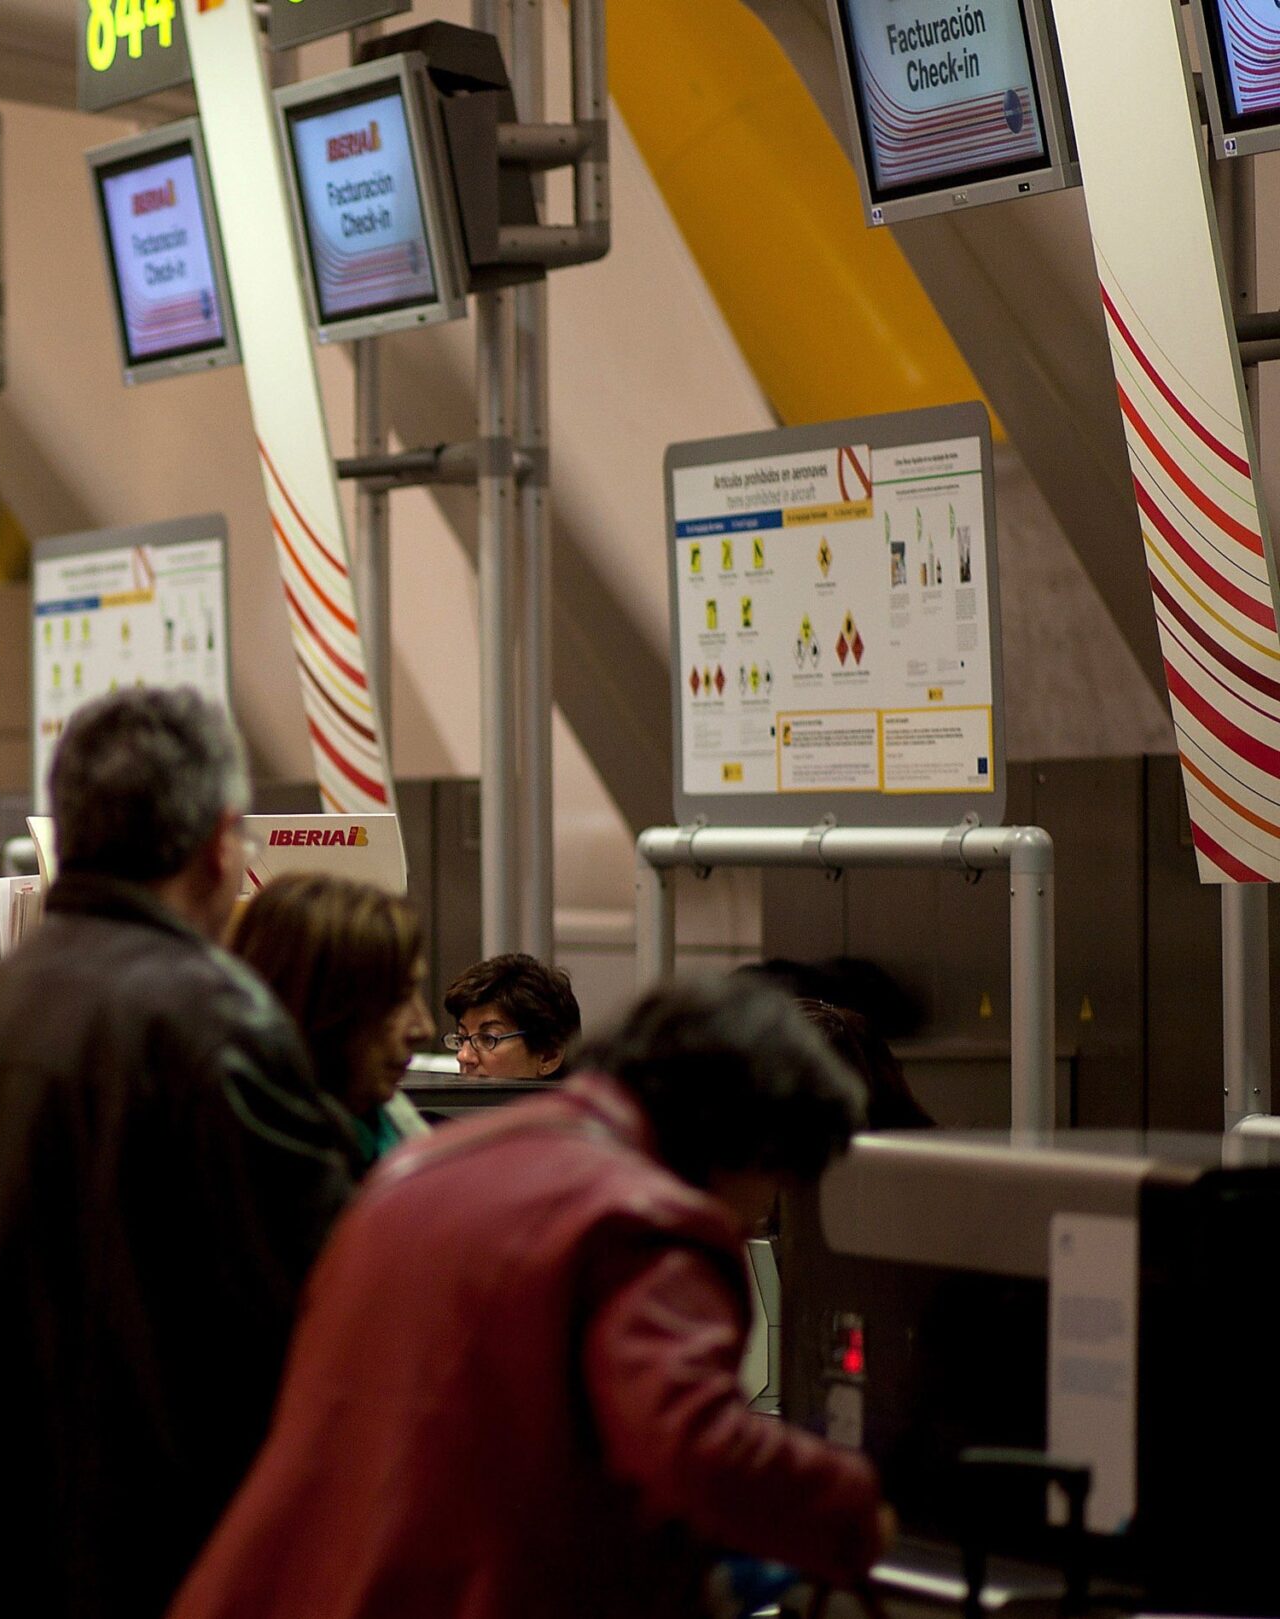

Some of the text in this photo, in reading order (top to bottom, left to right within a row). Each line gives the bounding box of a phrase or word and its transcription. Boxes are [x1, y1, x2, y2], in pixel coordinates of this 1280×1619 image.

[886, 5, 987, 55] Facturación
[907, 48, 980, 92] Check-in
[327, 170, 393, 206] Facturación
[341, 204, 392, 238] Check-in
[269, 829, 346, 847] IBERIA
